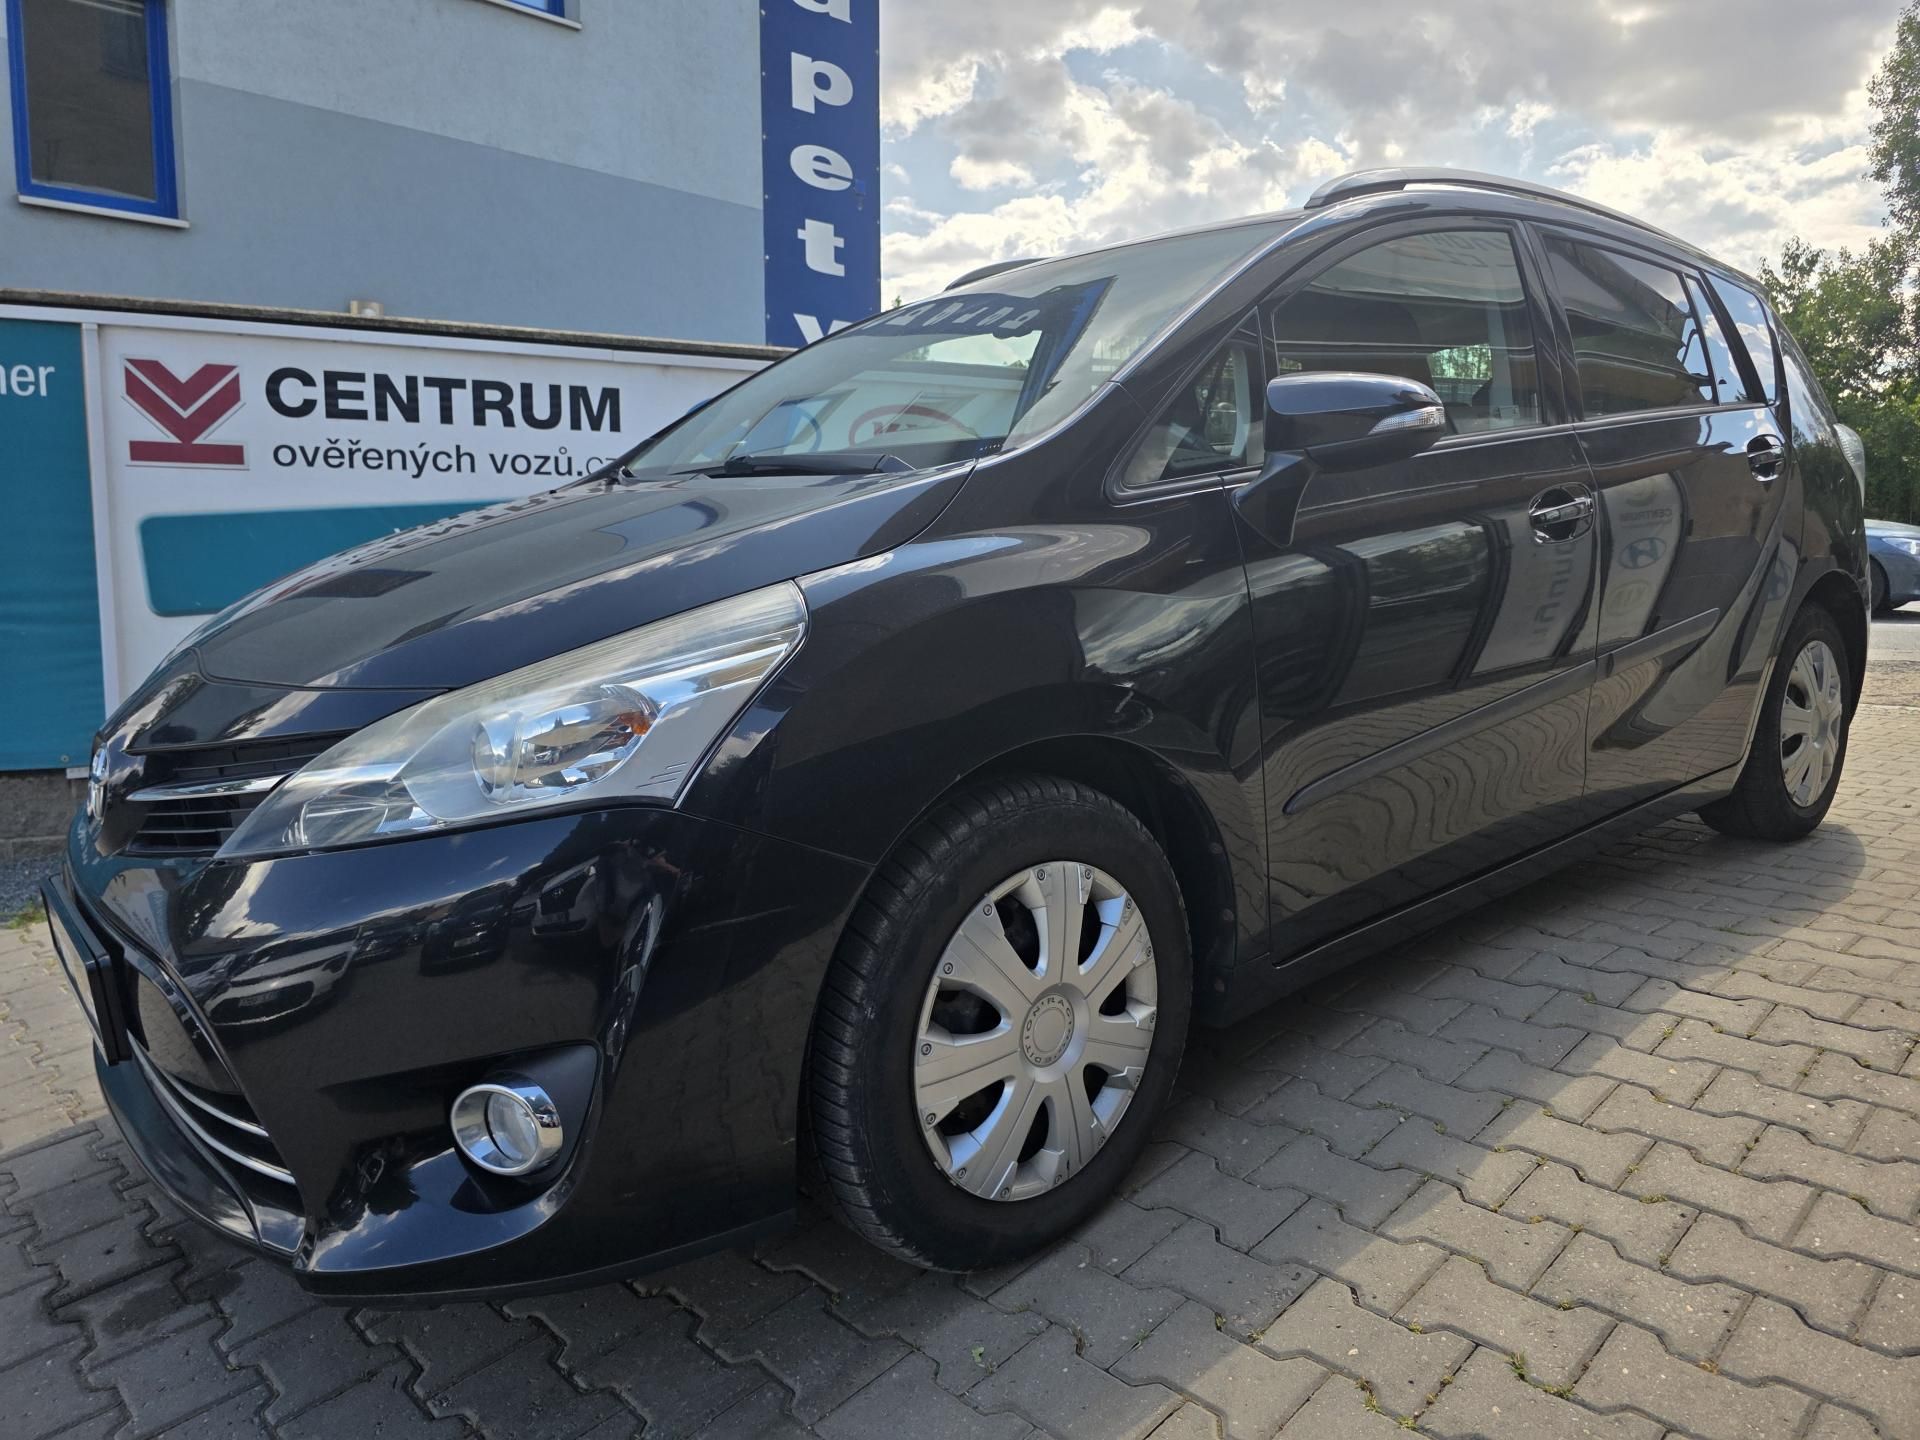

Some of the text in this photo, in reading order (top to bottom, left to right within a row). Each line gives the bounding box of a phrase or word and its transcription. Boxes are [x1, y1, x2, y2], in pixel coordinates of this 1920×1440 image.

[265, 367, 621, 433] CENTRUM
[272, 438, 617, 479] ověřených vozů.c
